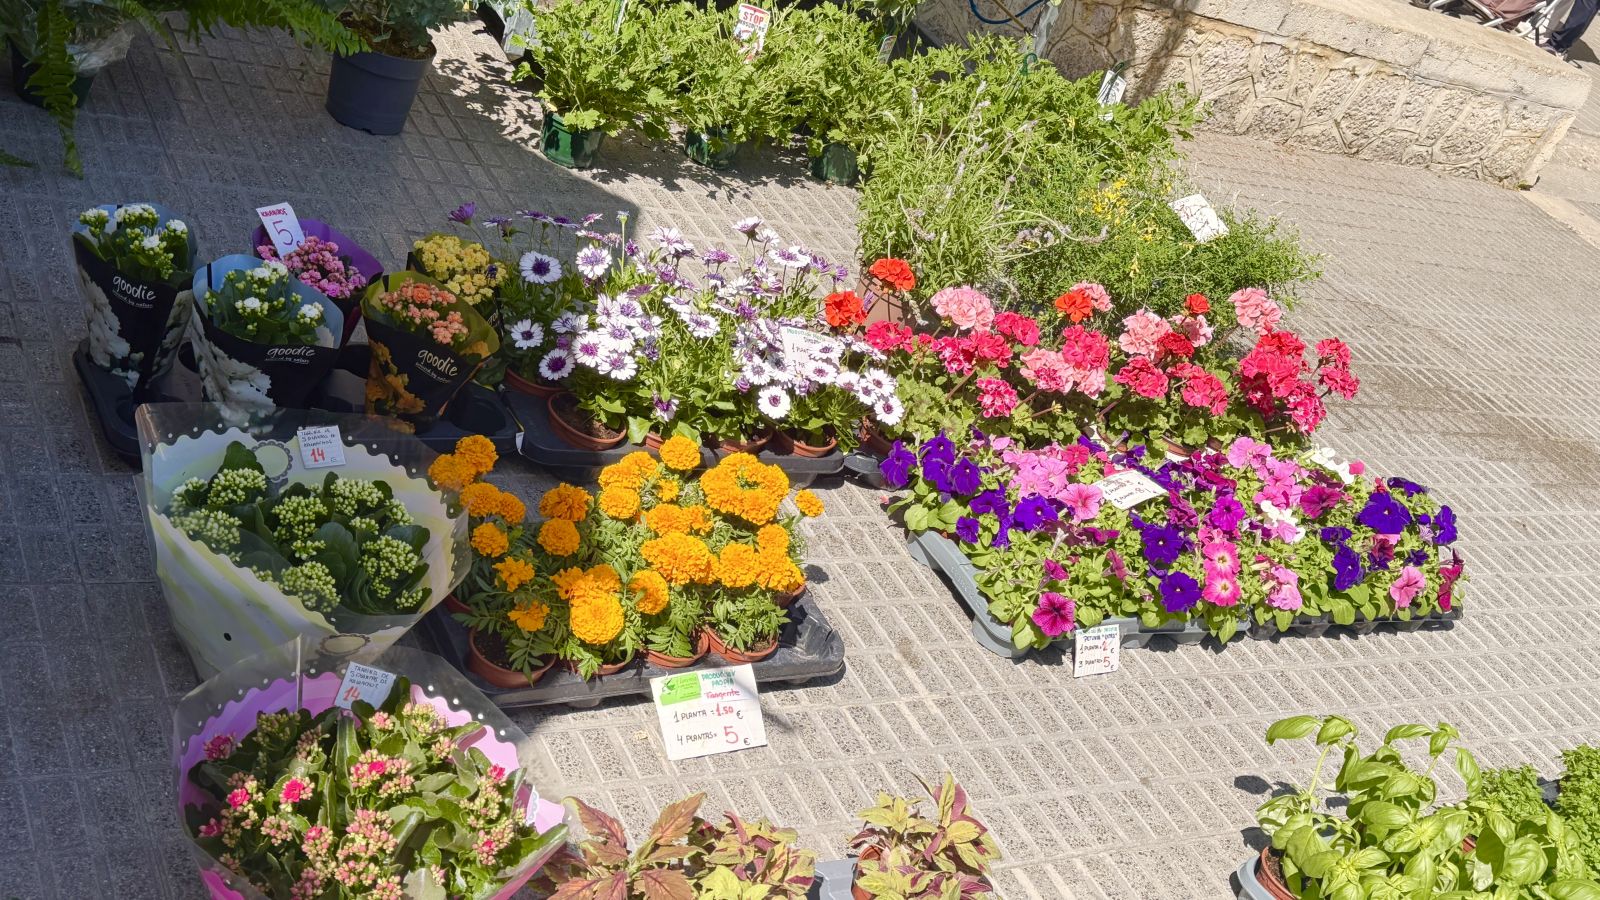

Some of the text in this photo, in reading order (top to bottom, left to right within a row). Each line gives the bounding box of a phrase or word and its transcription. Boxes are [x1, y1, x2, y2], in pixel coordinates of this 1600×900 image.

[742, 11, 764, 26] STOP
[272, 220, 294, 246] 5
[113, 276, 156, 300] goodie
[267, 345, 316, 358] goodie
[418, 349, 458, 376] goodie
[1103, 656, 1110, 668] 5
[673, 711, 680, 722] 1
[680, 709, 707, 720] PLANTA
[736, 710, 744, 720] €
[677, 734, 683, 745] 4
[723, 725, 739, 744] 5
[743, 737, 751, 746] €
